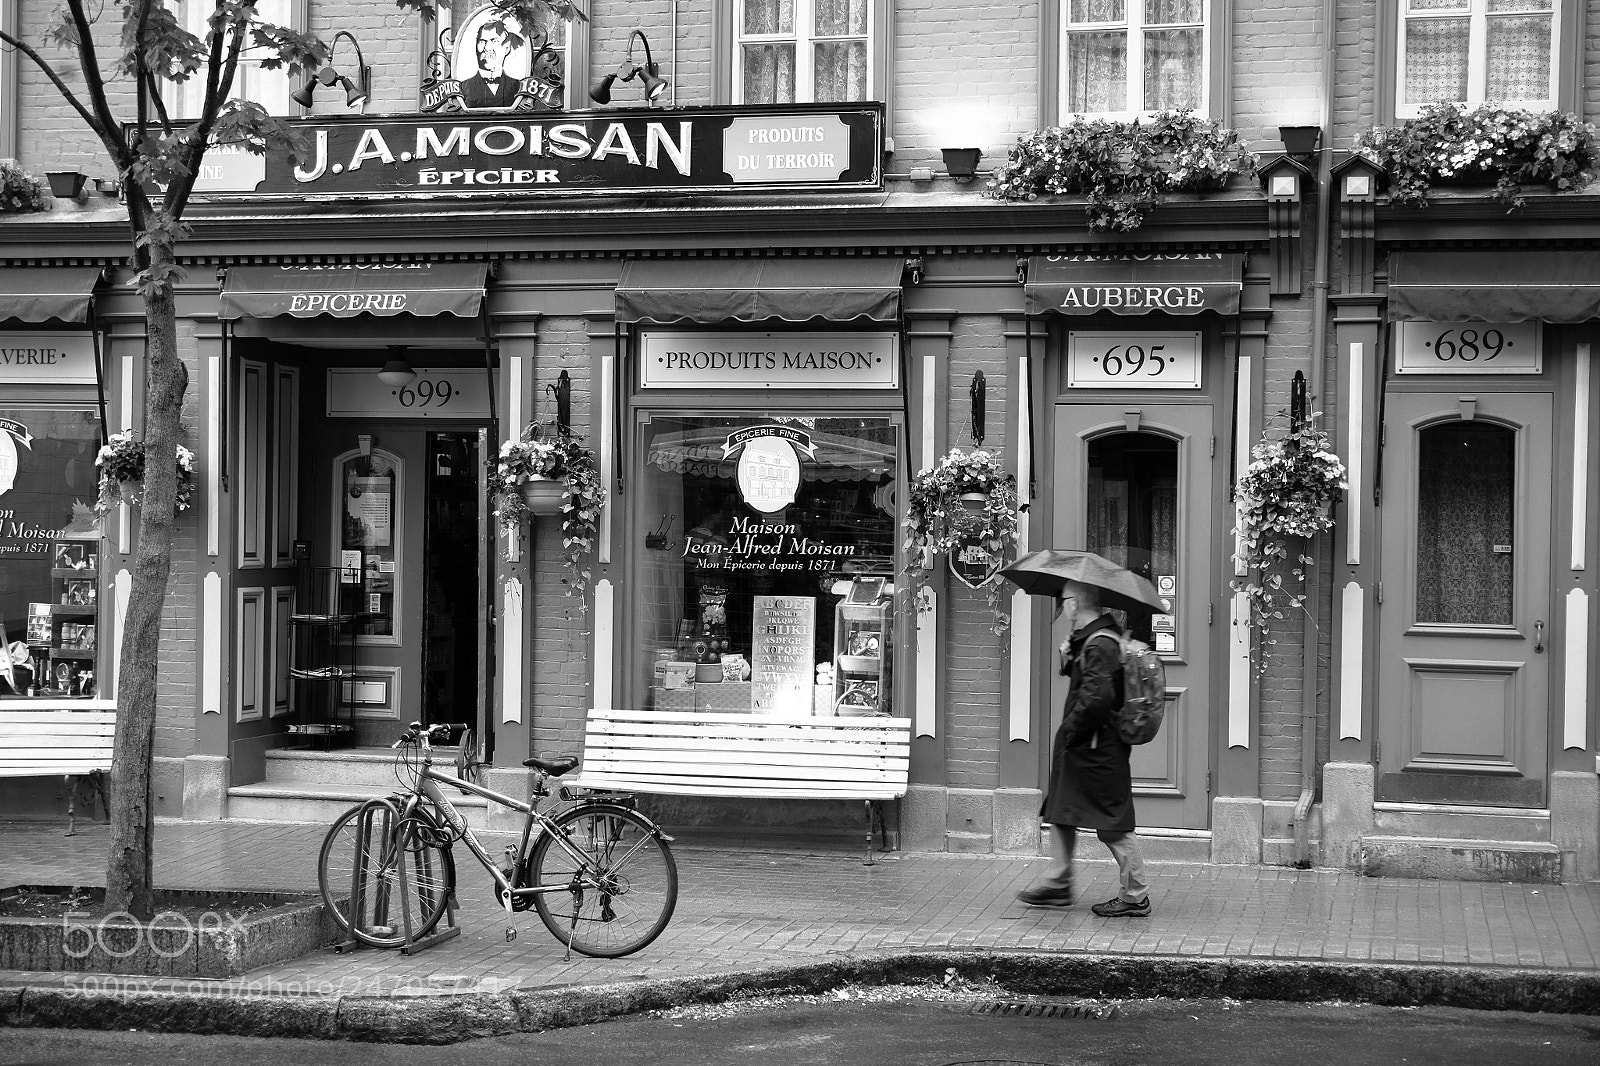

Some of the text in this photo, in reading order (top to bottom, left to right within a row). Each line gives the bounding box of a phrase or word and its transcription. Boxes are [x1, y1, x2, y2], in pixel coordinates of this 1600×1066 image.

[425, 79, 555, 107] DEPUIS 1871
[748, 126, 824, 144] PRODUITS
[737, 152, 835, 170] DU TERROIR
[289, 293, 407, 312] ÉPICERIE
[1060, 287, 1205, 308] AUBERGE
[1434, 329, 1504, 362] 689
[665, 351, 873, 370] PRODUITS MAISON
[1102, 344, 1165, 376] 695
[398, 380, 452, 408] 699
[0, 421, 18, 432] FINE
[779, 429, 800, 441] FINE
[7, 522, 66, 539] Moisan
[728, 516, 796, 535] Maison
[24, 543, 49, 553] 1871
[681, 534, 855, 559] Jean-Alfred Moisan
[695, 555, 836, 572] Mon Épicerie depuis 1871
[757, 625, 810, 634] GHIJKL
